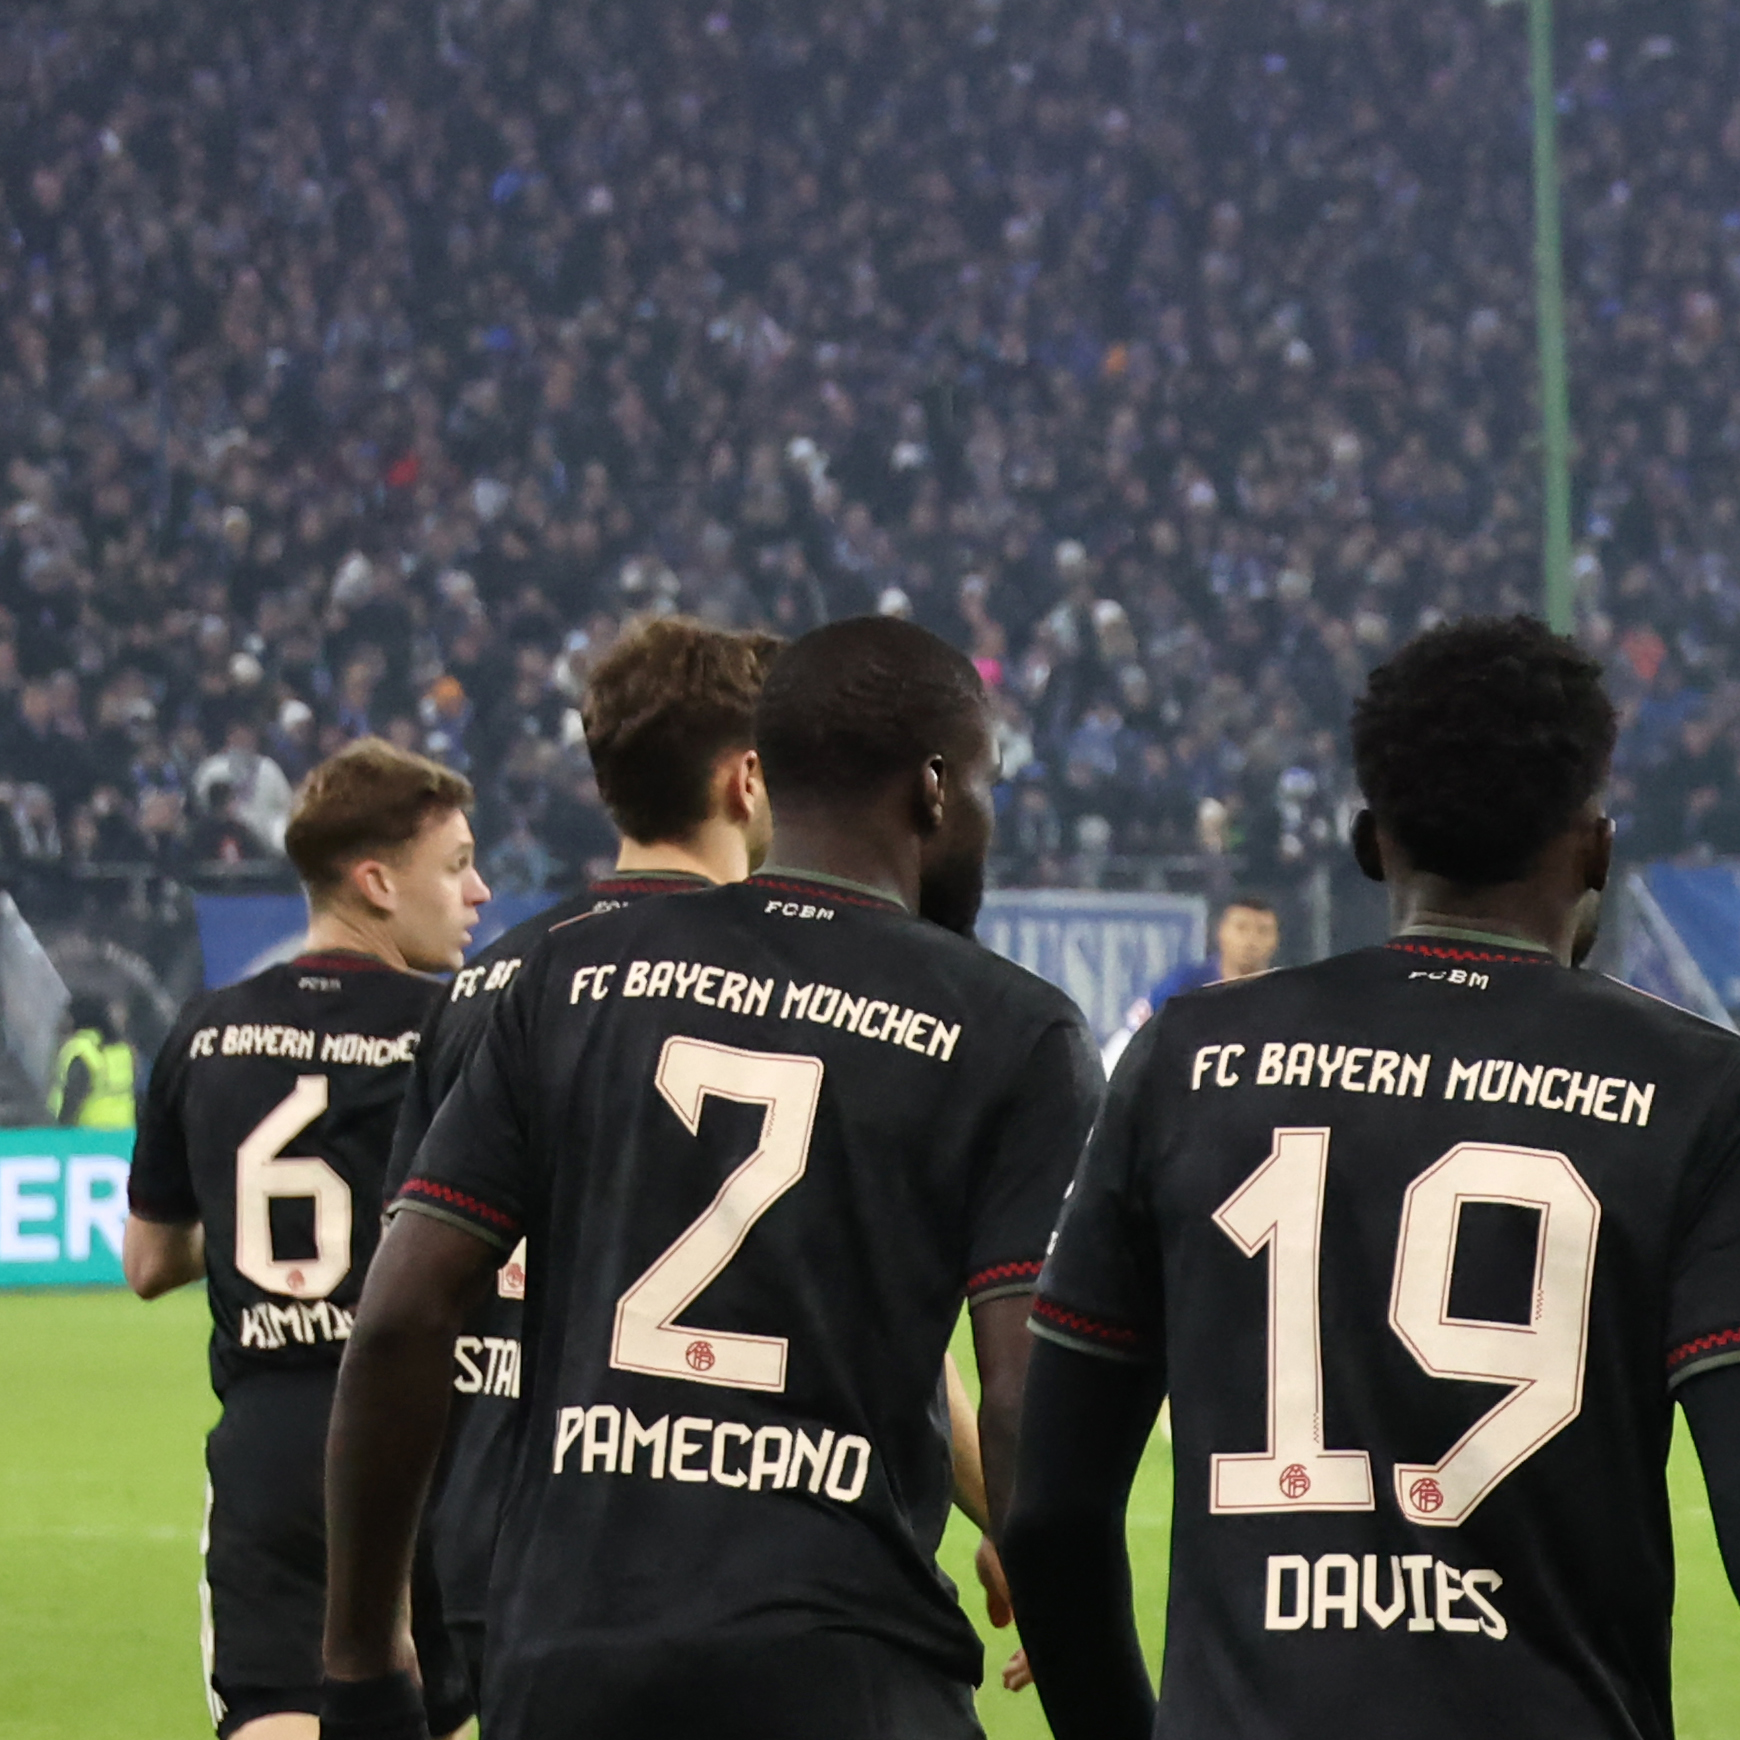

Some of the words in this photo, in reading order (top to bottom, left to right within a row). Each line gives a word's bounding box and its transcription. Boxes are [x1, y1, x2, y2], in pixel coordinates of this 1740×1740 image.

[764, 899, 835, 921] FCBM
[450, 965, 486, 1002] FC
[569, 964, 617, 1005] FC
[622, 960, 775, 1017] BAYERN
[780, 979, 962, 1062] MÜNCHEN
[189, 1026, 219, 1059] FC
[221, 1023, 315, 1060] BAYERN
[1191, 1043, 1246, 1091] FC
[1256, 1042, 1431, 1098] BAYERN
[1444, 1056, 1656, 1127] MÜNCHEN
[235, 1075, 352, 1299] 6
[609, 1034, 825, 1393] 2
[240, 1300, 356, 1350] KIMMI
[1210, 1127, 1602, 1527] 19
[553, 1404, 872, 1502] PAMECANO
[1264, 1553, 1508, 1641] DAVIES
